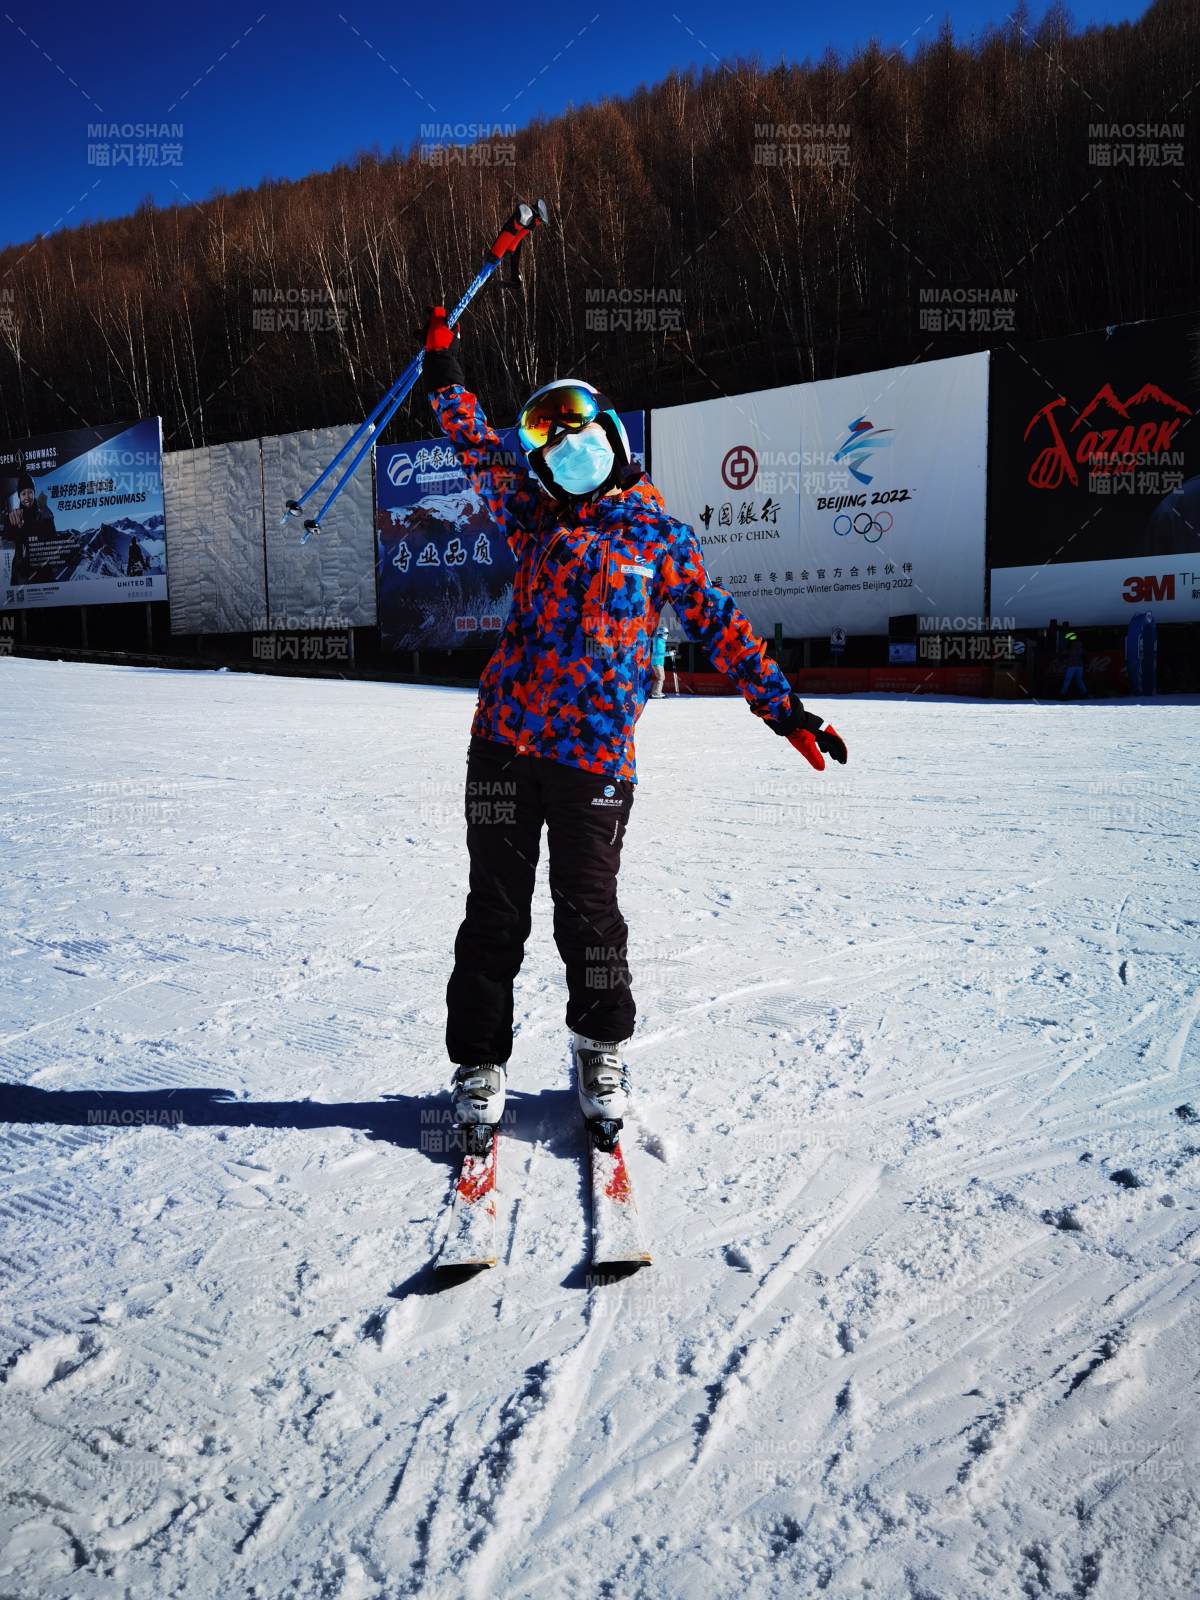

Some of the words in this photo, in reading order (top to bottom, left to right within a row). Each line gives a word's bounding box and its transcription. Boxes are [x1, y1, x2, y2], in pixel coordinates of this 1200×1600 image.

[1076, 418, 1181, 464] OZARK
[99, 492, 146, 507] SNOWMASS
[817, 493, 867, 512] BEIJING
[871, 489, 912, 505] 2022
[701, 534, 727, 545] BANK
[730, 533, 743, 543] OF
[746, 529, 780, 541] CHINA
[729, 574, 748, 584] 2022
[752, 588, 761, 597] of
[761, 587, 773, 596] the
[774, 586, 805, 597] Olympic
[807, 584, 832, 593] Winter
[834, 583, 861, 592] Games
[863, 580, 891, 591] Beijing
[892, 578, 913, 588] 2022
[1122, 574, 1175, 603] 3M
